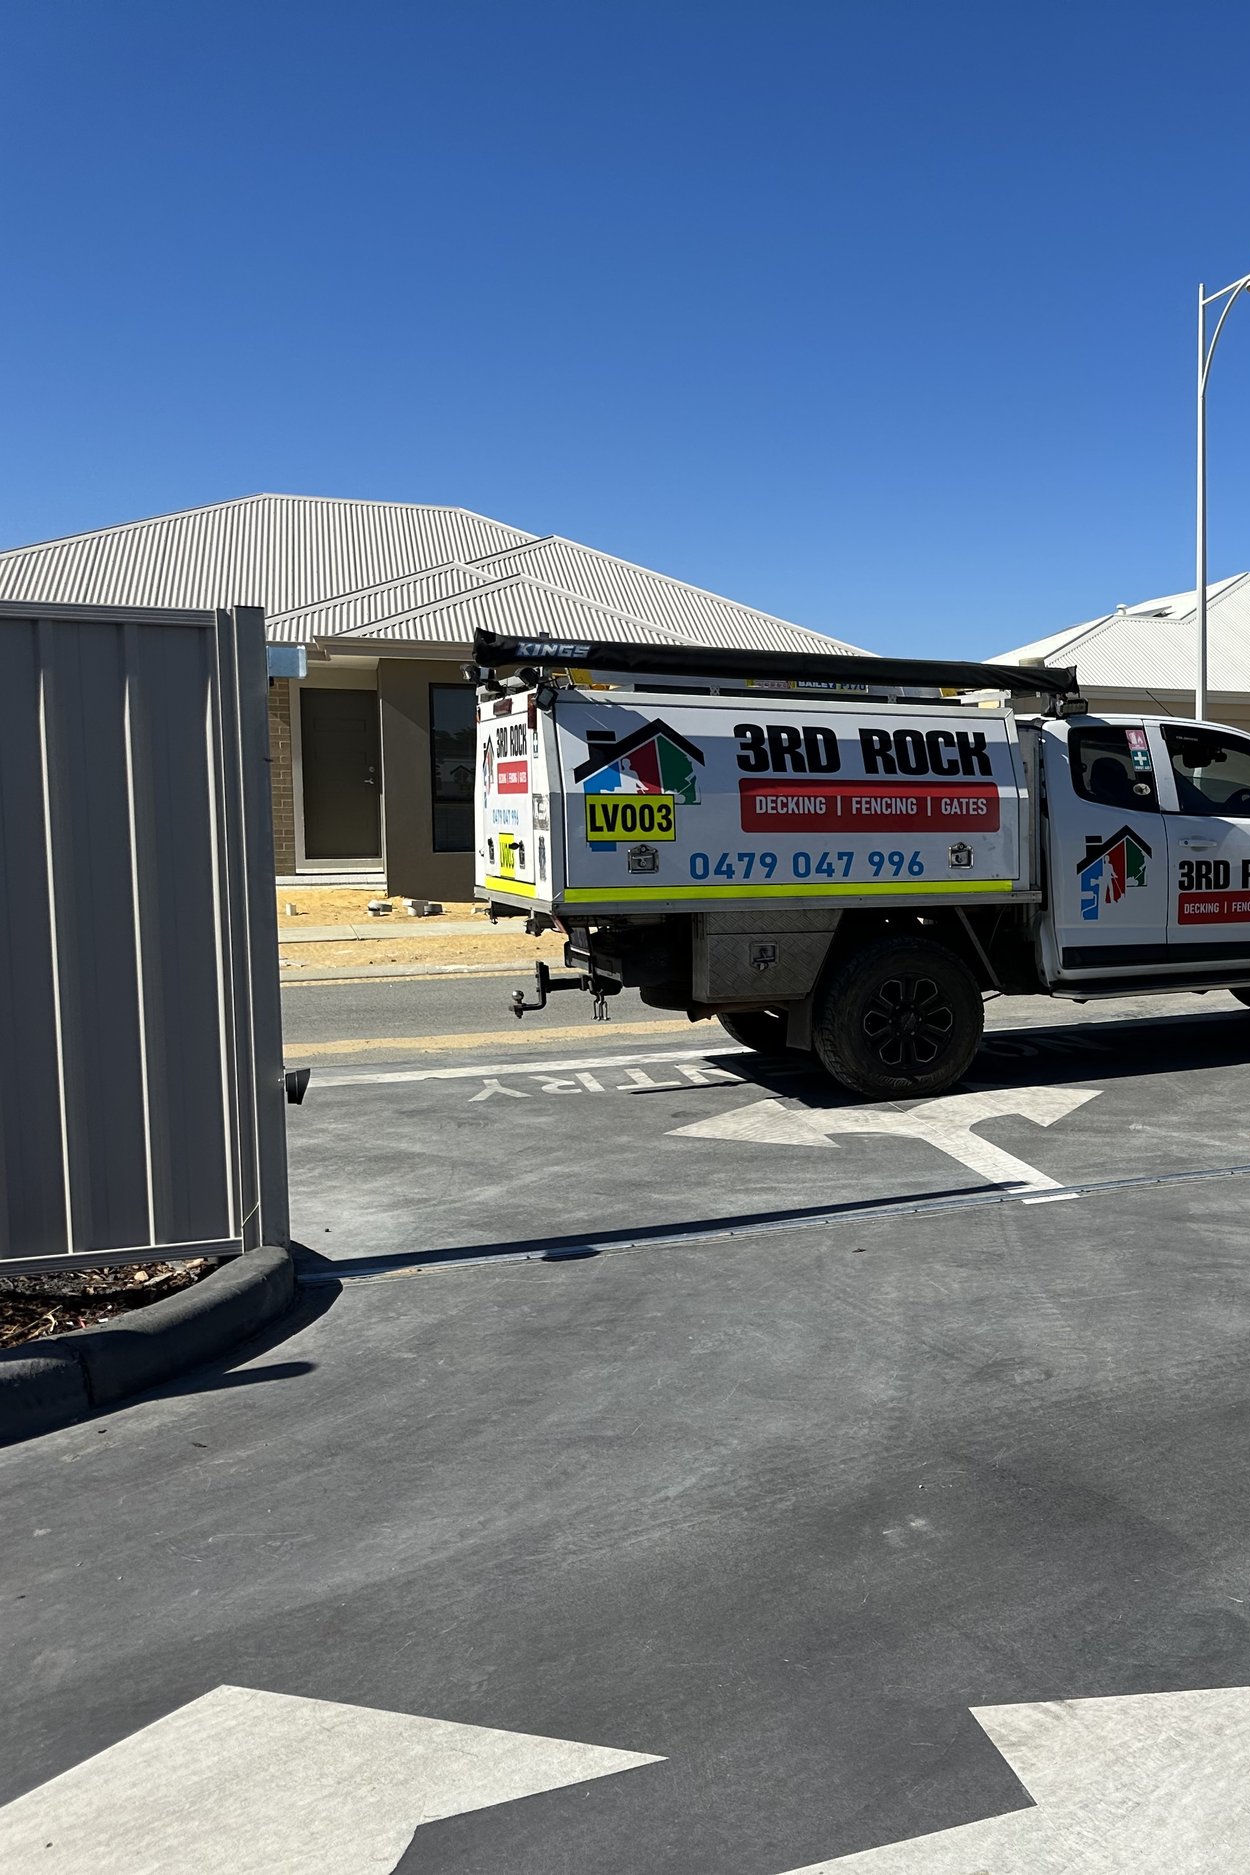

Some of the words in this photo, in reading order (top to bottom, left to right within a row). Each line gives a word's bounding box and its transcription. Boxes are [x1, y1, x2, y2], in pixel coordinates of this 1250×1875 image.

[516, 642, 591, 658] KINGS
[797, 681, 834, 689] BAILEY
[496, 727, 508, 758] 3RD
[510, 723, 527, 757] ROCK
[733, 723, 841, 774] 3RD
[858, 728, 993, 777] ROCK
[589, 803, 674, 833] LV003
[755, 796, 826, 814] DECKING
[852, 797, 917, 815] FENCING
[941, 798, 987, 815] GATES
[690, 852, 777, 880] 0479
[792, 852, 855, 878] 047
[868, 851, 925, 877] 996
[1178, 860, 1230, 891] 3RD
[1184, 903, 1219, 914] DECKING
